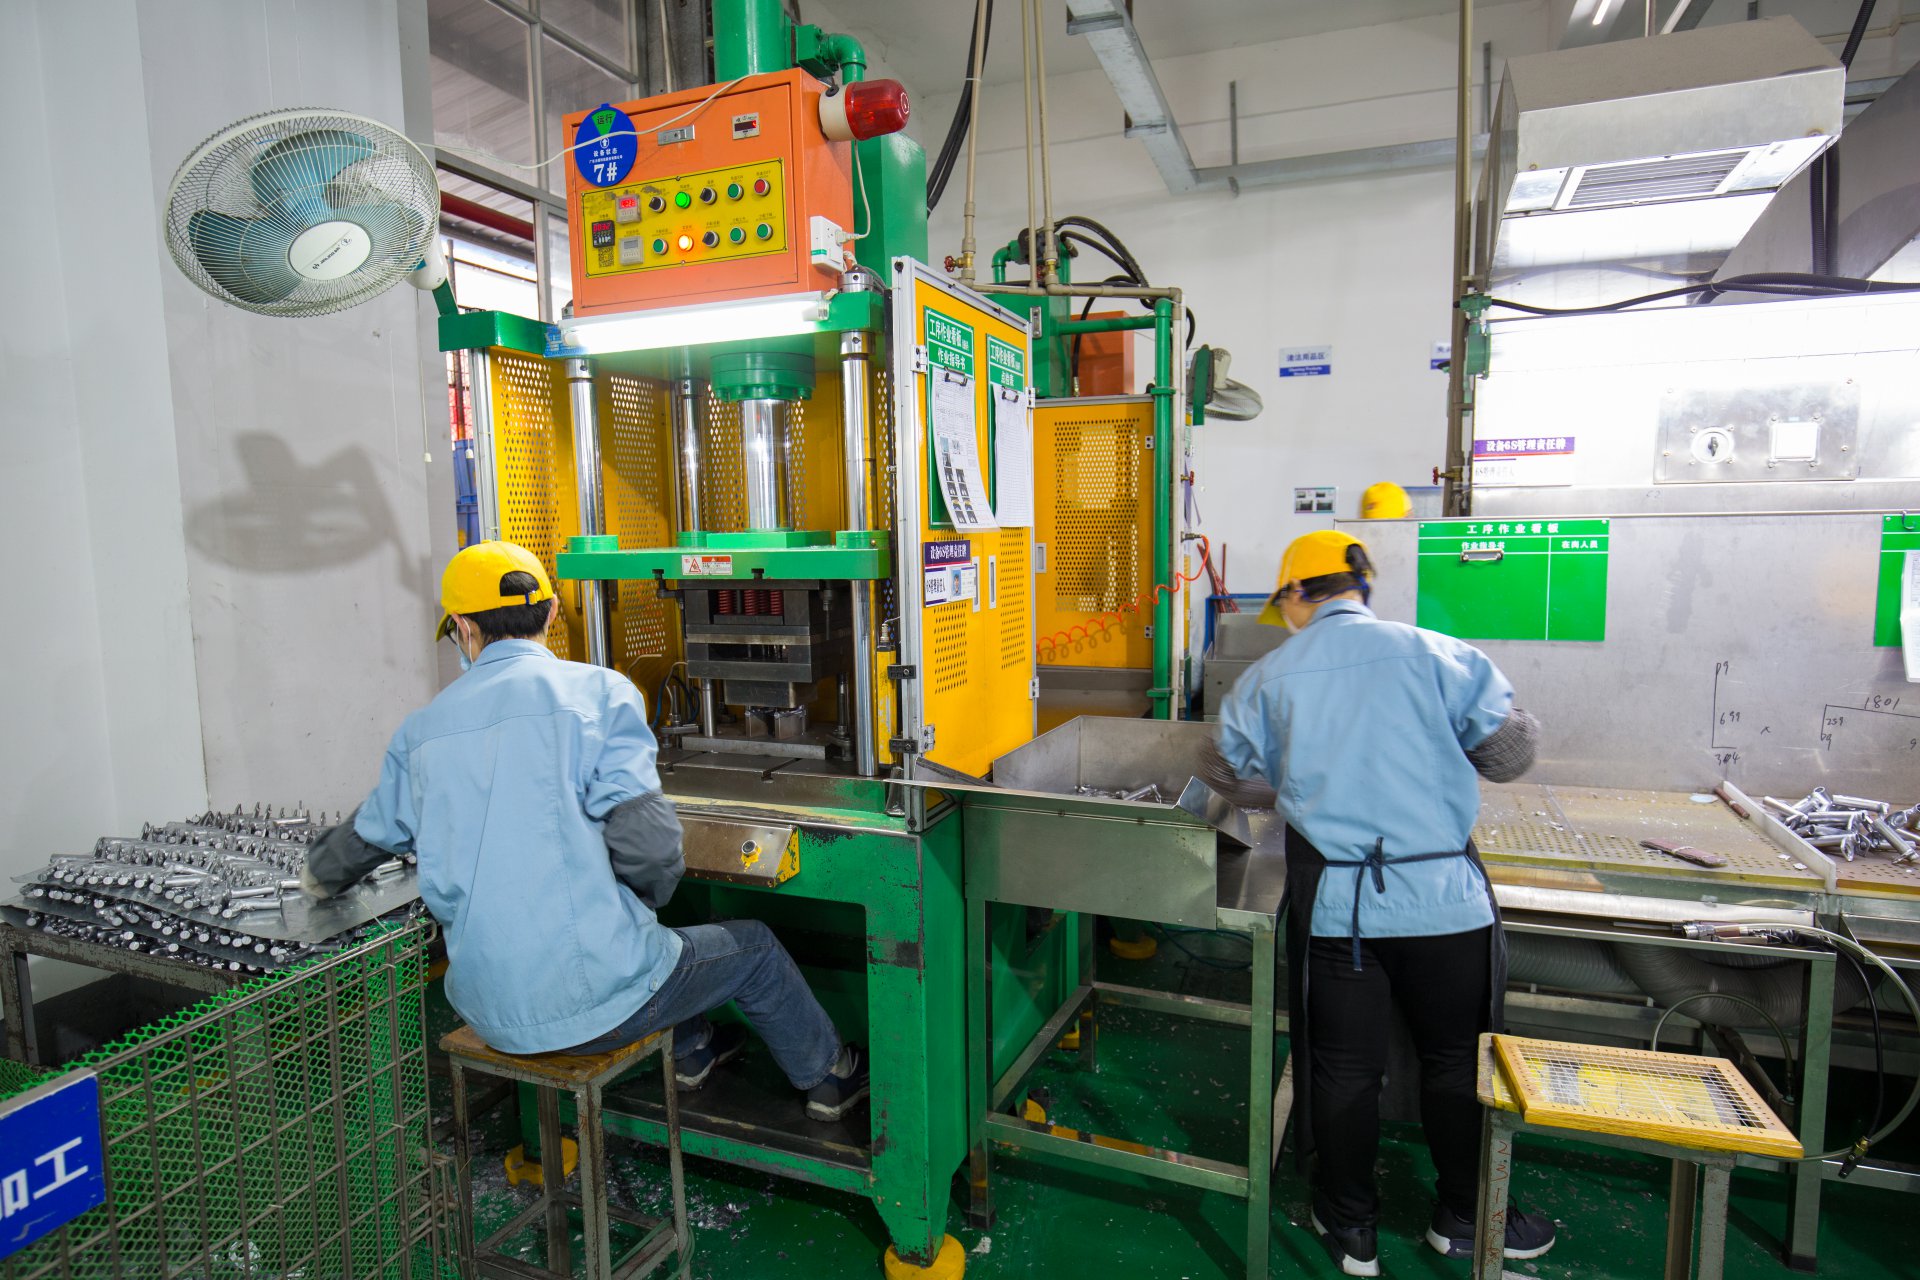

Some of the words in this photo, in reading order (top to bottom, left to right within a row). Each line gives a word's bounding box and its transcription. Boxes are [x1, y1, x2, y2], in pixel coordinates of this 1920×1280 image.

[597, 113, 613, 125] 运行
[593, 147, 618, 158] 设备状态
[593, 162, 618, 184] 7#
[929, 319, 961, 347] 工序作业看板
[937, 347, 966, 370] 作业指导书
[991, 344, 1015, 368] 工序作业看板
[1486, 437, 1566, 452] 设备6S管理责任牌
[1467, 523, 1559, 534] 工序作业看板
[1461, 541, 1505, 550] 作业指导书
[1561, 540, 1598, 549] 在岗人员
[1864, 695, 1900, 711] 1801
